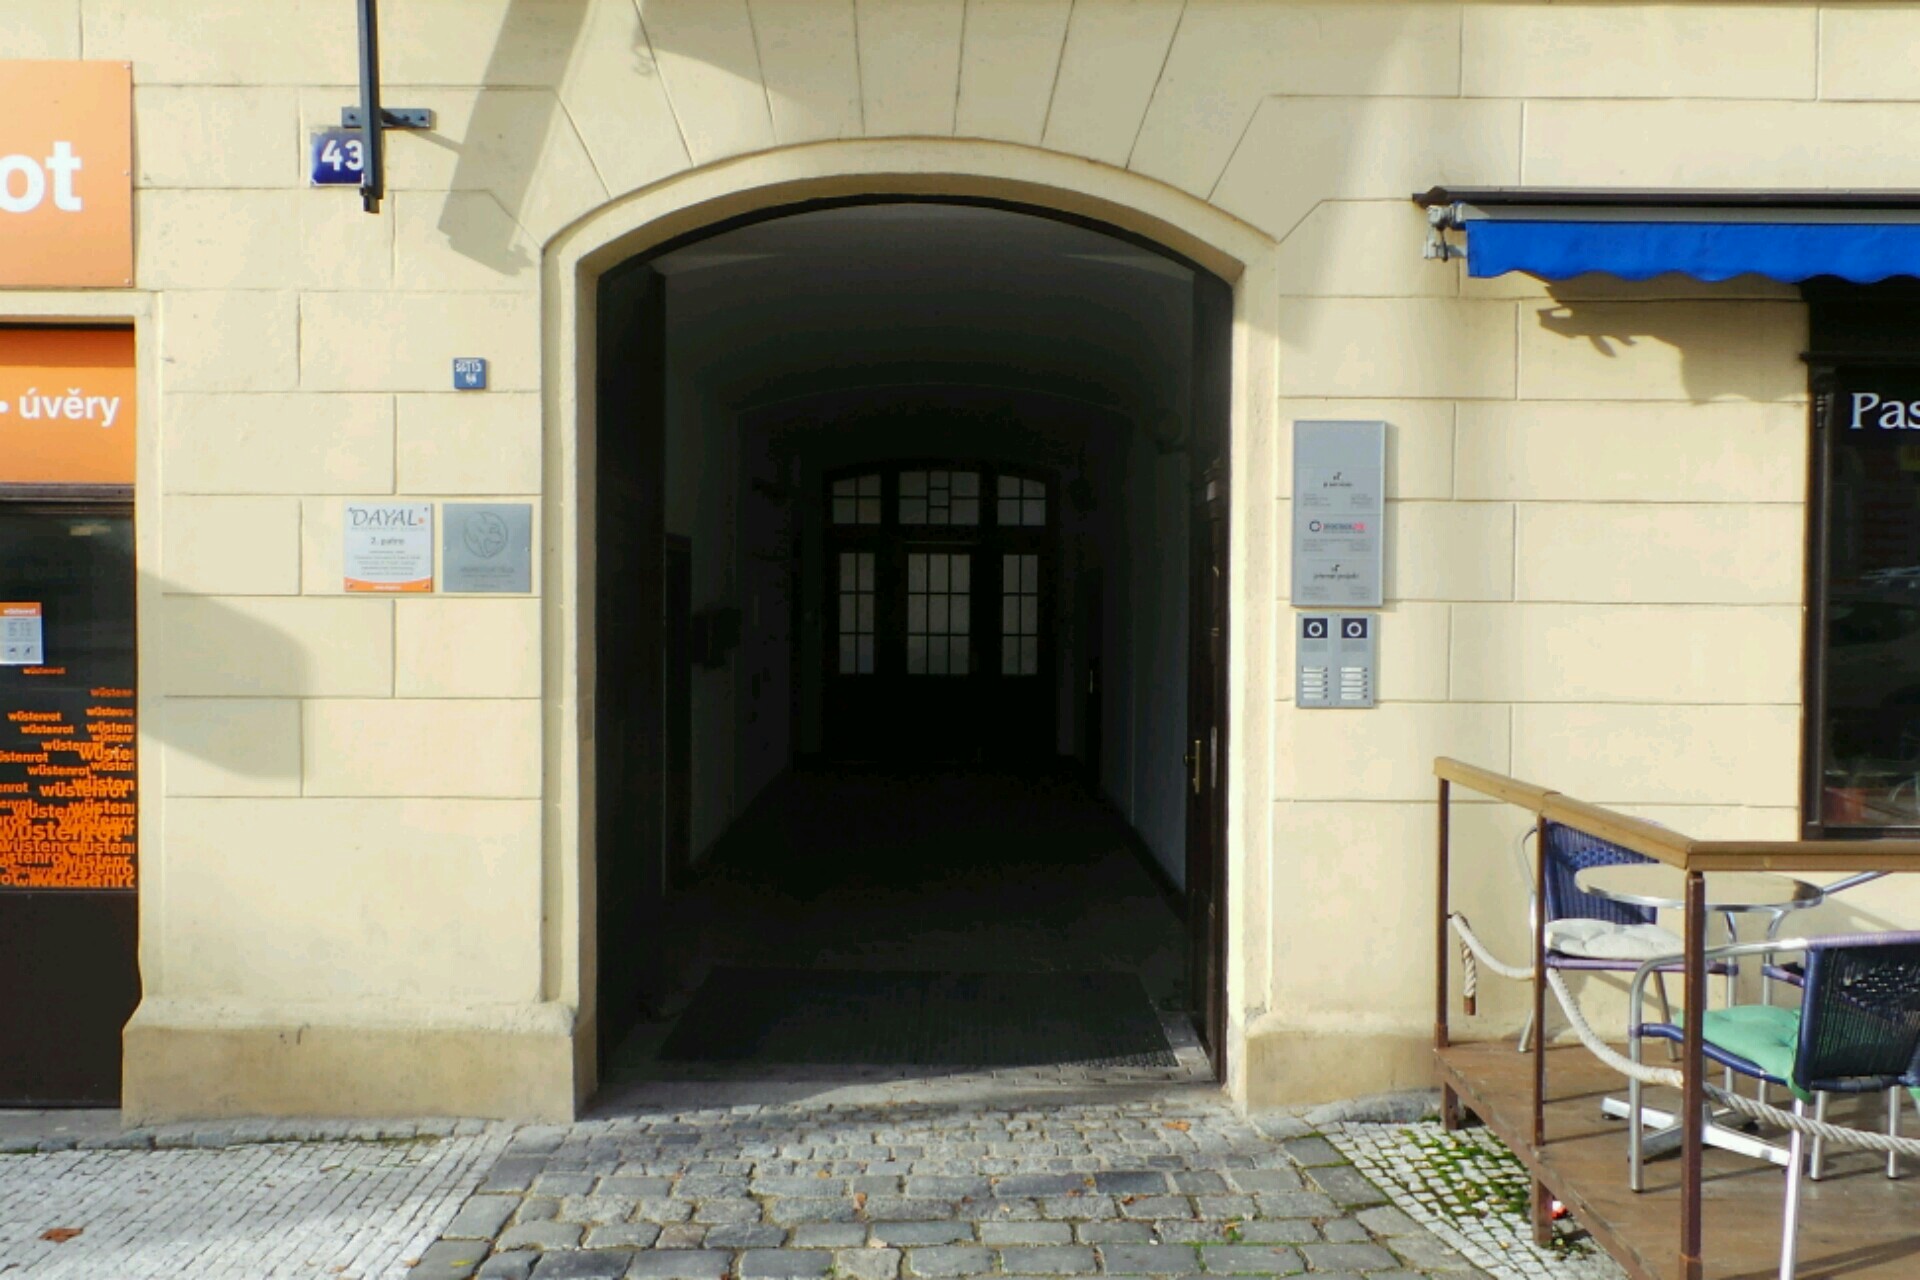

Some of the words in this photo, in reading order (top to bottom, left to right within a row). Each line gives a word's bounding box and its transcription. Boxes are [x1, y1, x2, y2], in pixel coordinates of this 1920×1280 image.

[321, 139, 364, 171] 43
[0, 141, 83, 213] ot
[19, 387, 120, 428] úvěry
[1850, 392, 1920, 429] Pas
